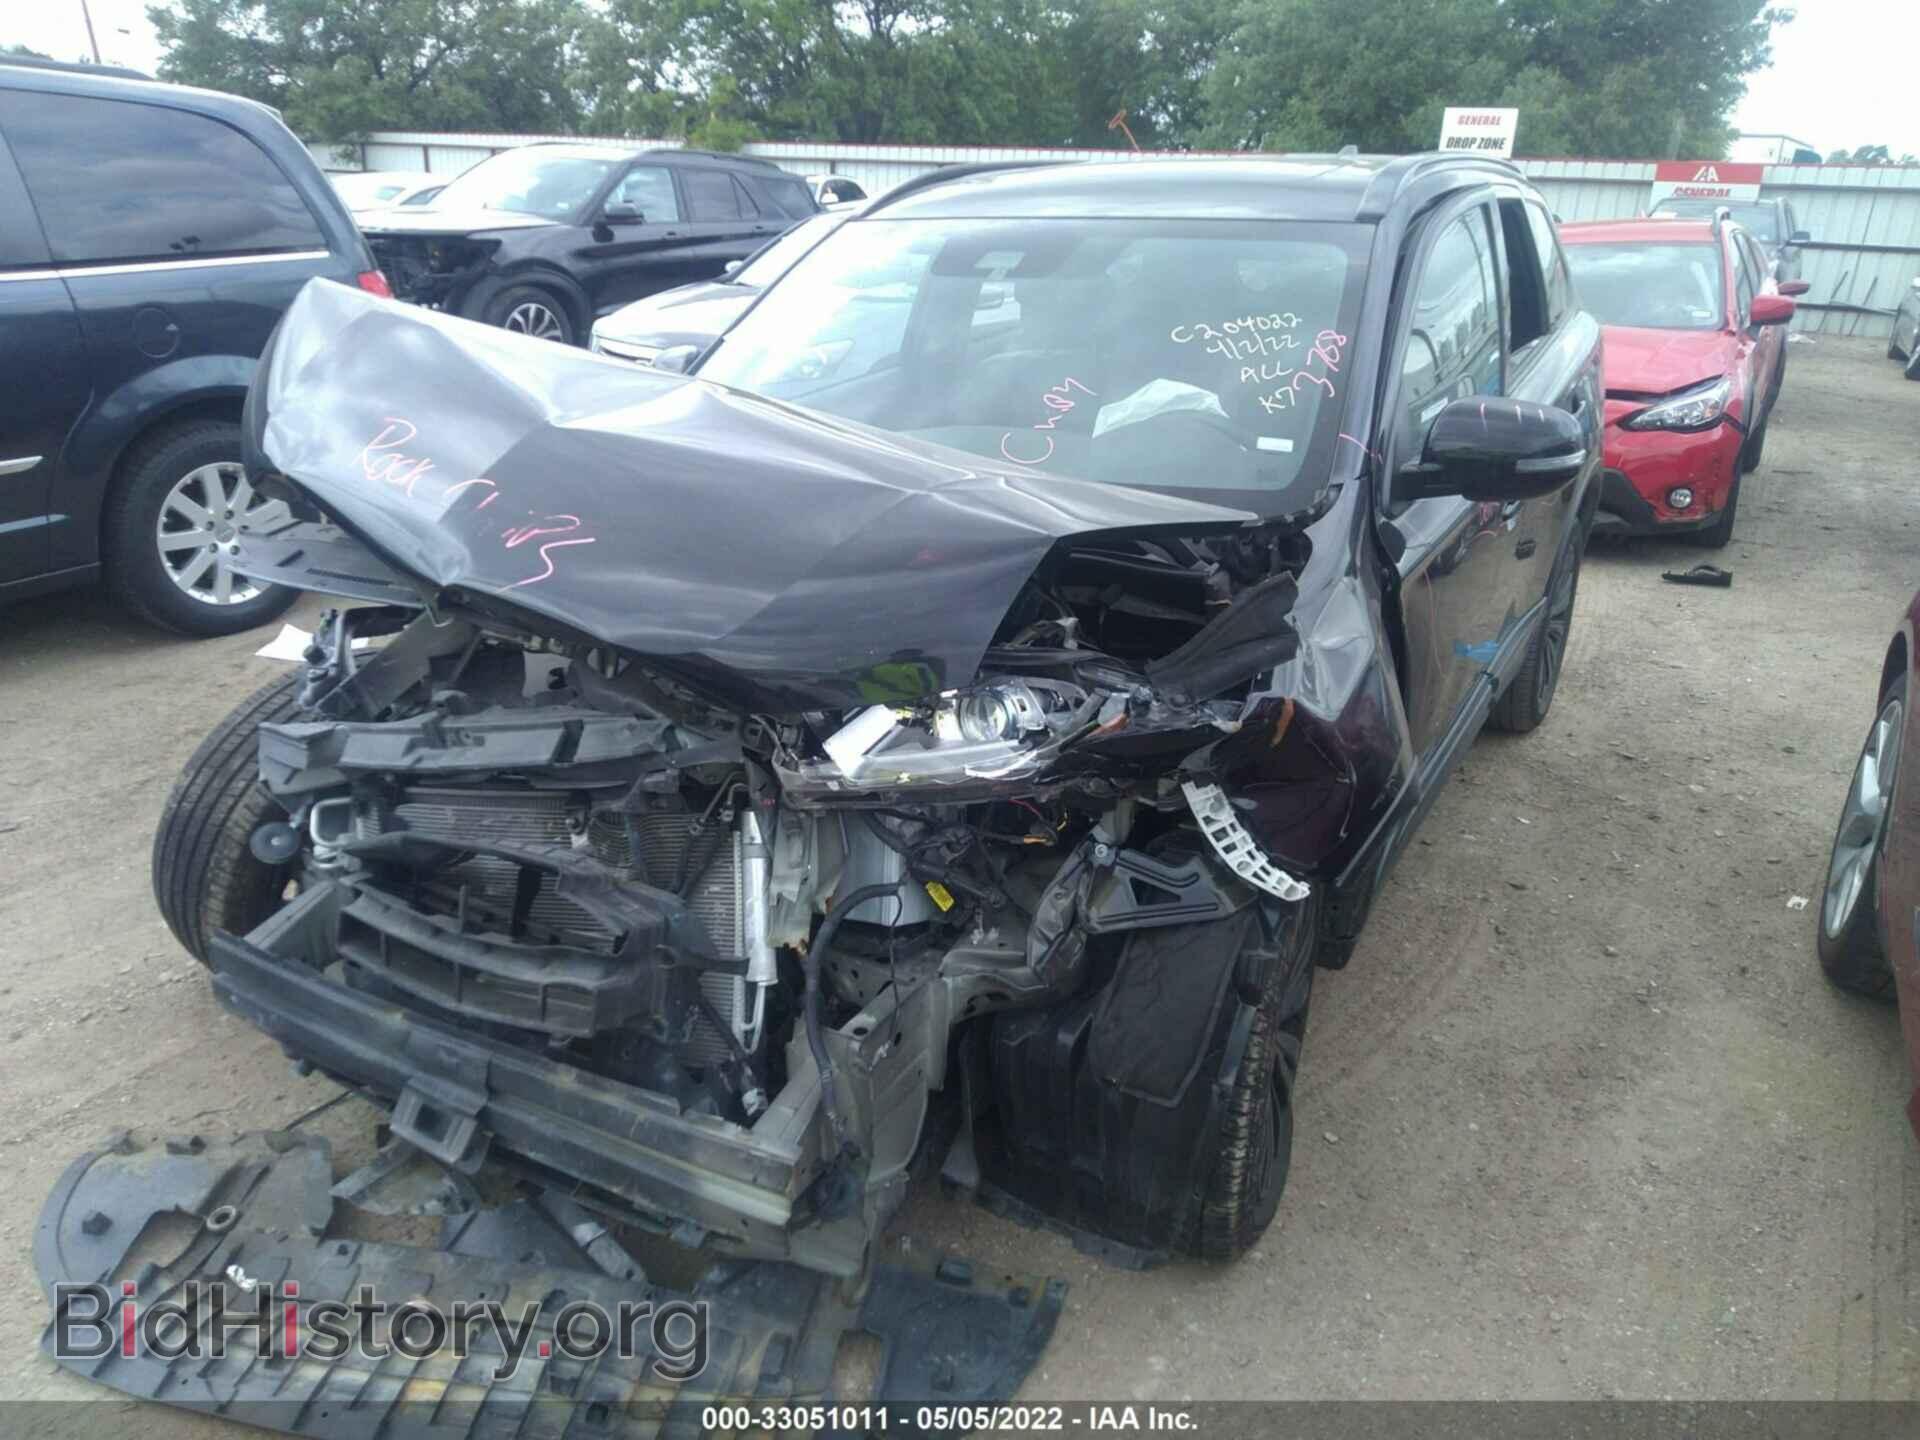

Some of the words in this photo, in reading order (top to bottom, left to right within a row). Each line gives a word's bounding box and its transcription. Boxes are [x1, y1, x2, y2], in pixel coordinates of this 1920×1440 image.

[1457, 114, 1502, 126] GENERAL
[1446, 136, 1477, 149] DROP
[1477, 136, 1507, 150] ZONE
